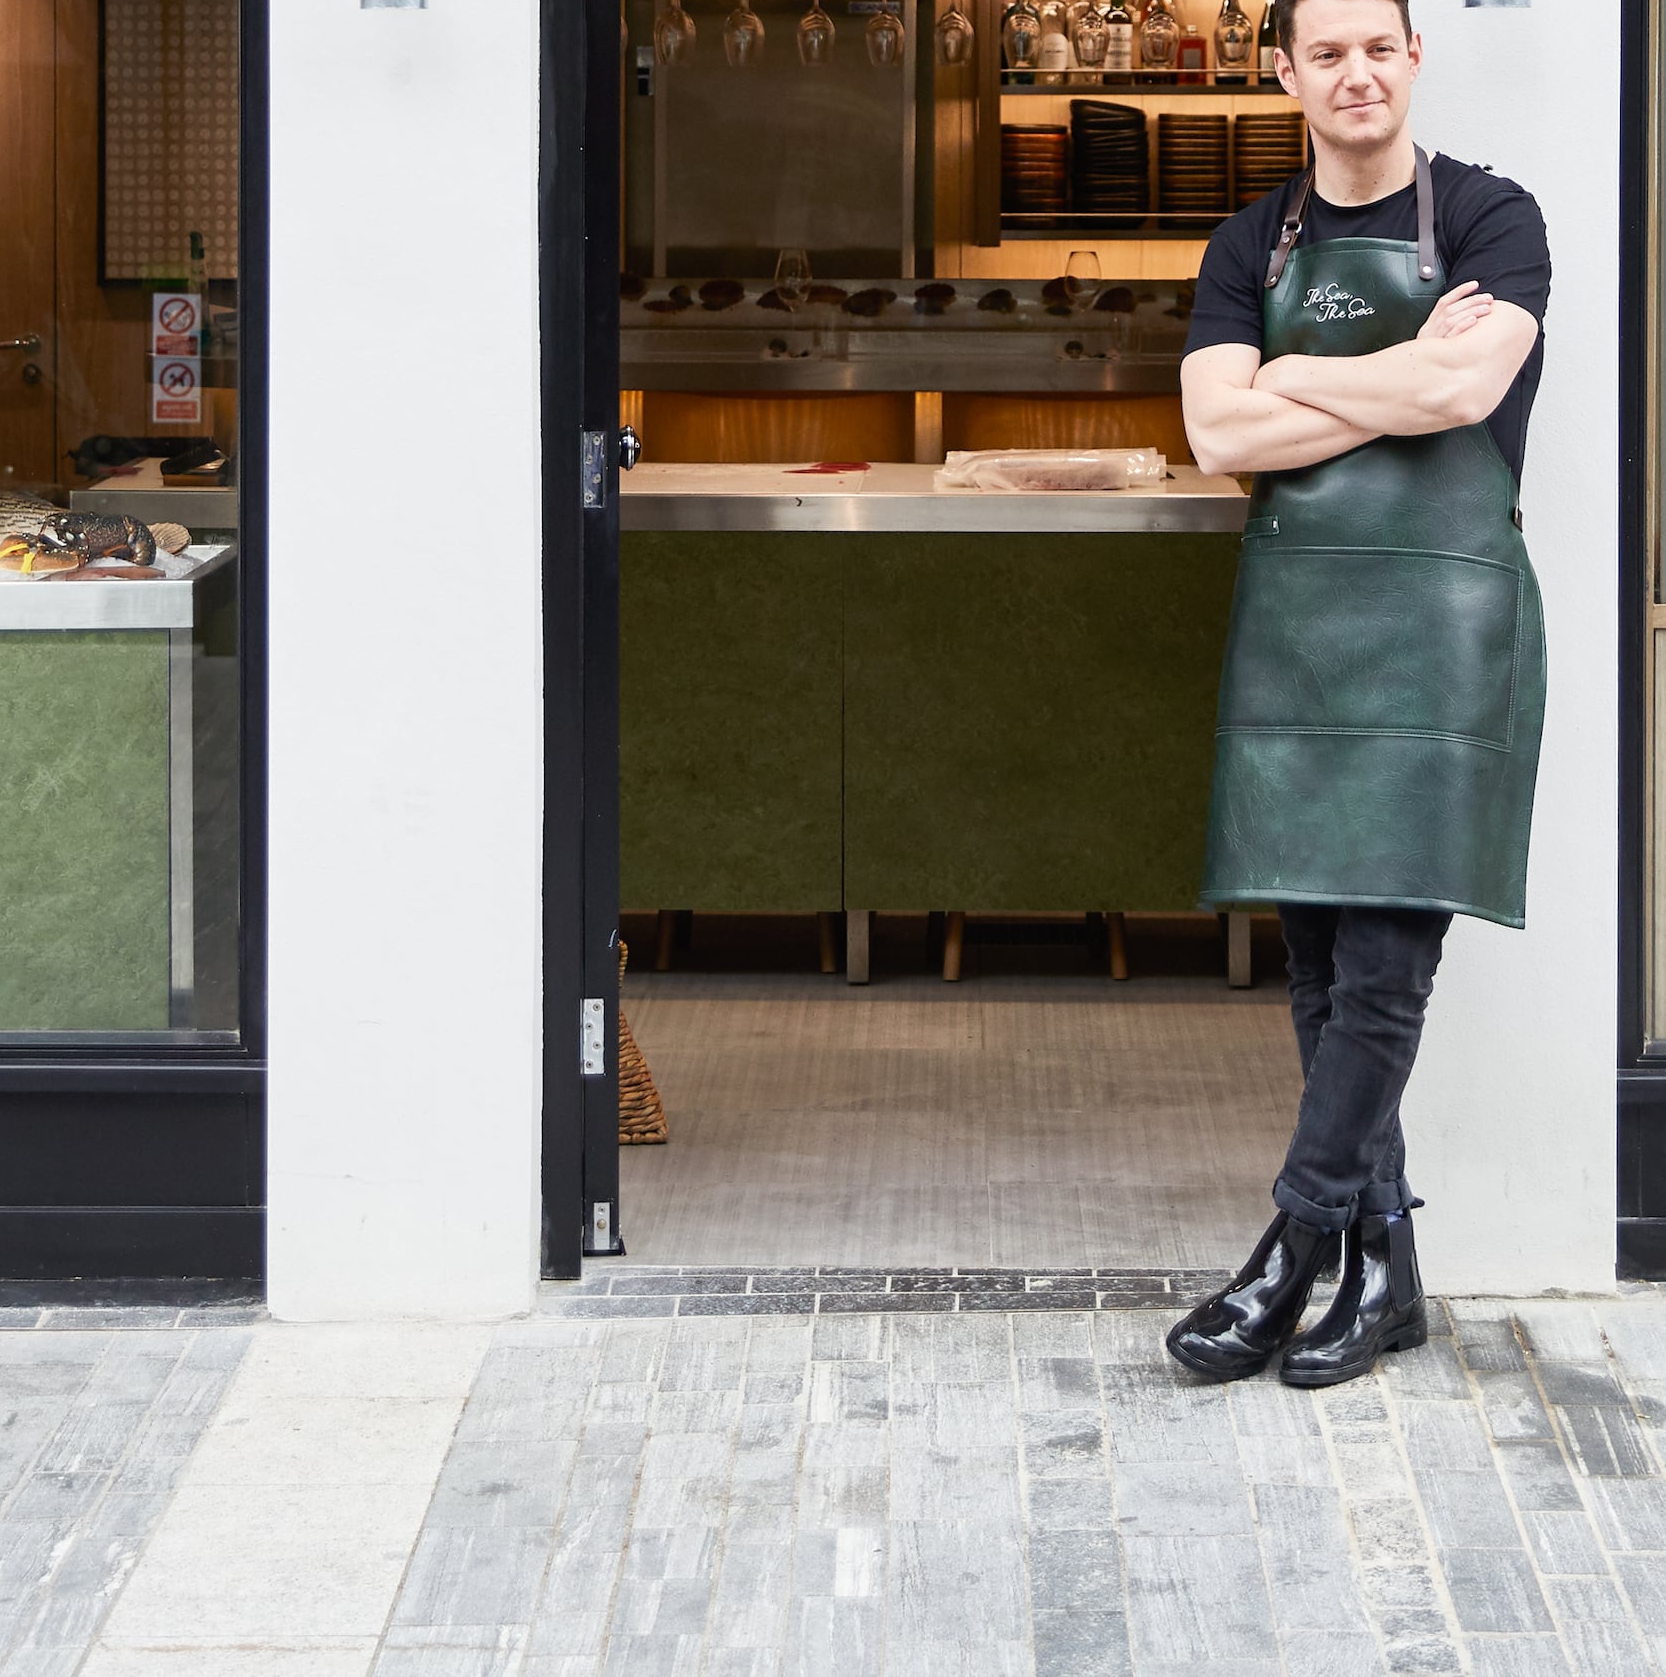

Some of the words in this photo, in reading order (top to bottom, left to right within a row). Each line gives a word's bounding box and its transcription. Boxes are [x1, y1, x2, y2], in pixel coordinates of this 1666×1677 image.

[1302, 288, 1326, 307] The
[1316, 303, 1346, 323] The
[1347, 297, 1376, 319] Sea
